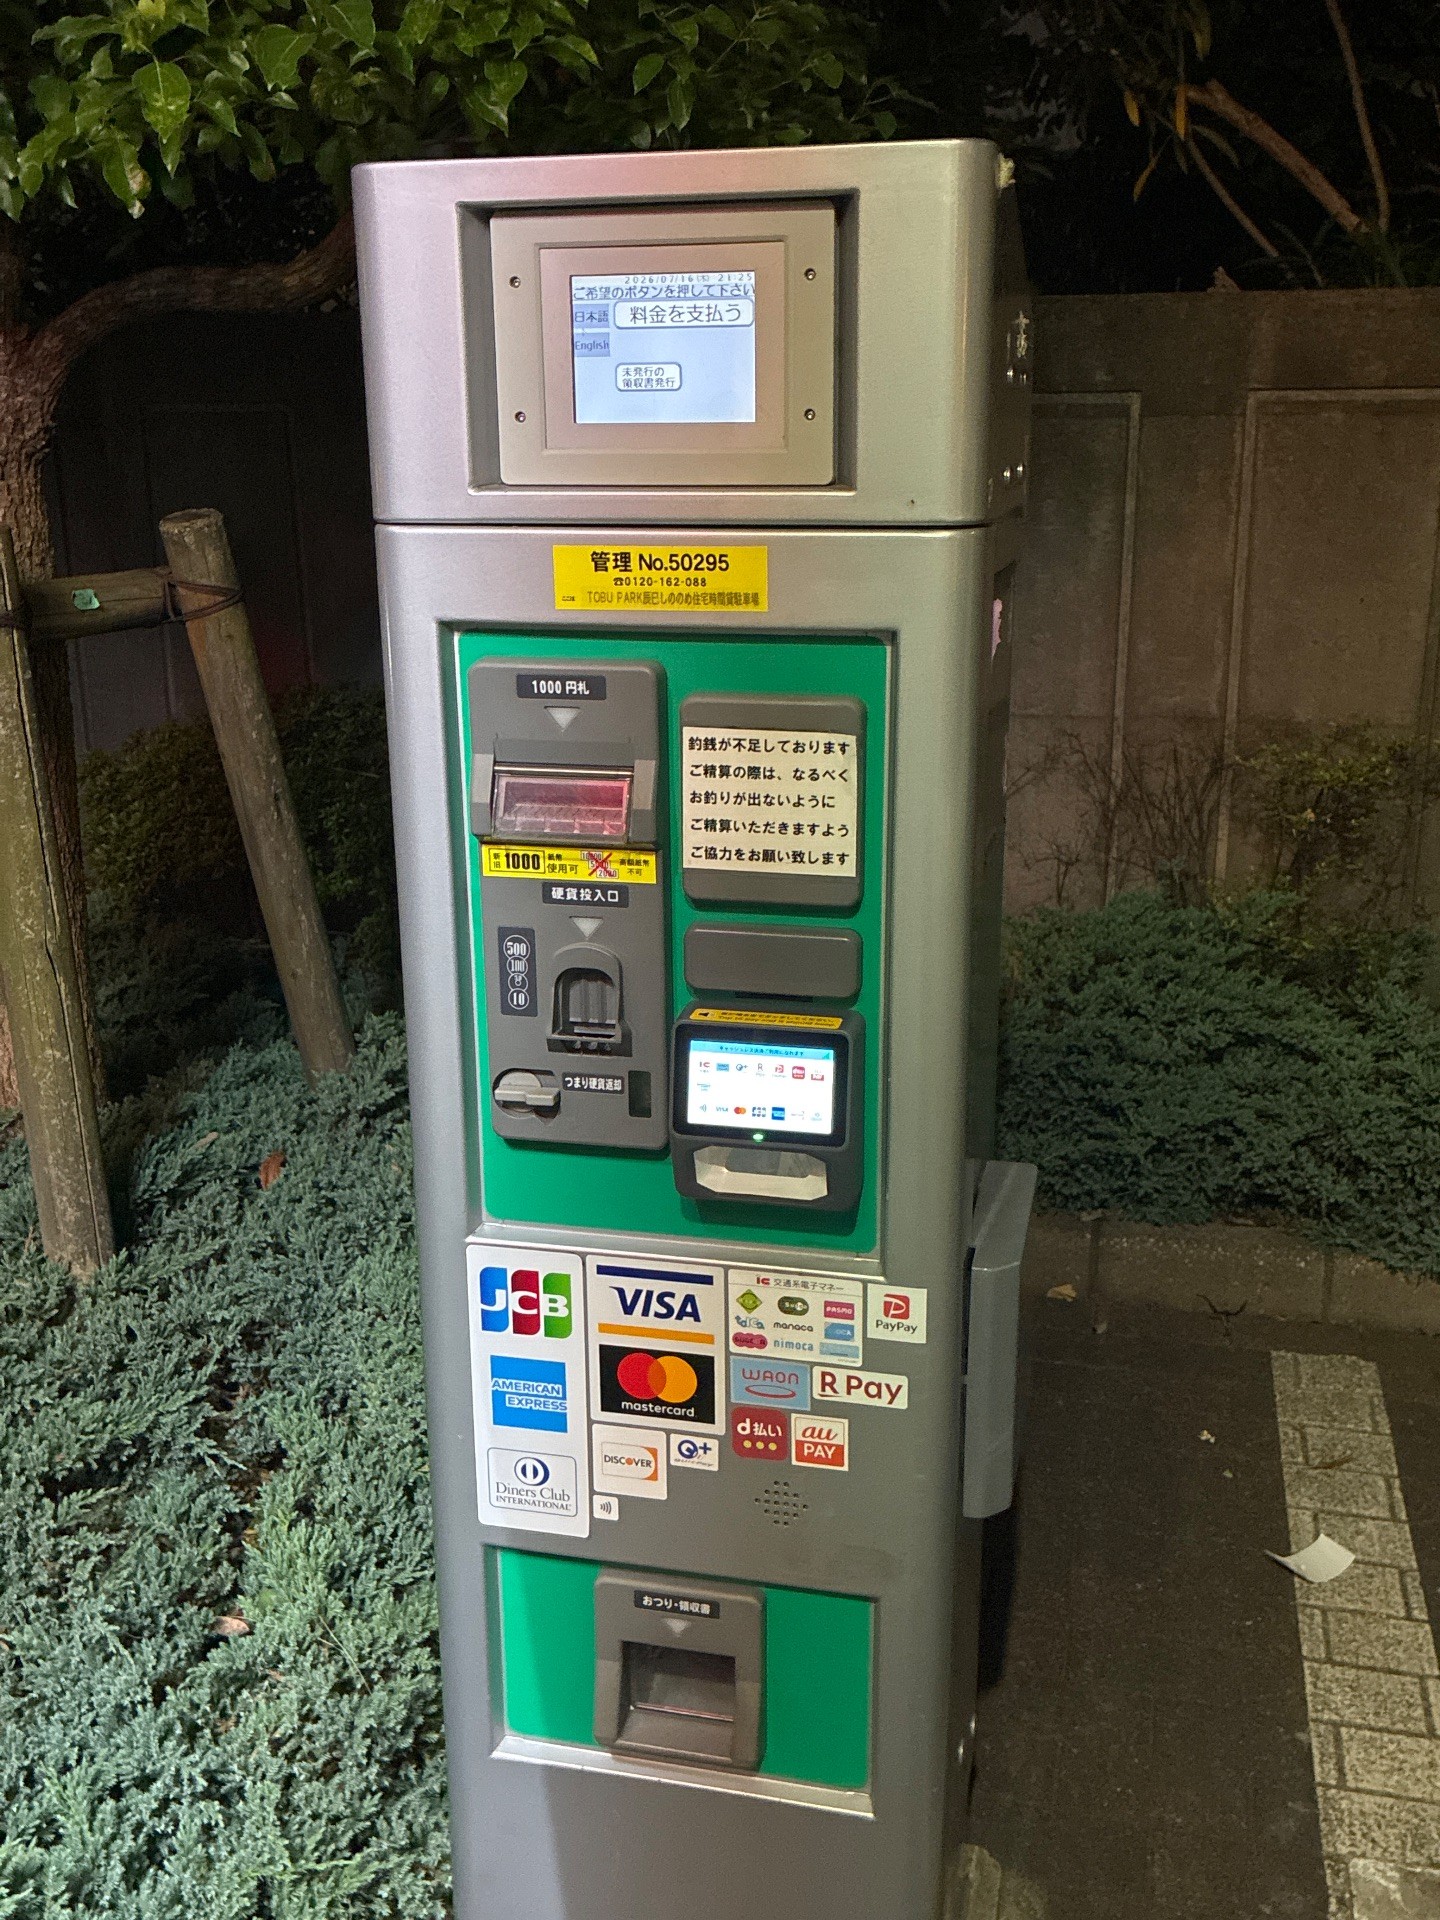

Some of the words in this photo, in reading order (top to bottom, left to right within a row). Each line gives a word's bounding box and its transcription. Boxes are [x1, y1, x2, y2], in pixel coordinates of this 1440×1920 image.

[573, 284, 755, 299] ご希望のボタンを押して下さい
[574, 310, 609, 323] 日本語
[629, 304, 741, 324] 料金を支払う
[575, 340, 609, 351] English
[622, 367, 665, 377] 未発行の
[622, 377, 675, 388] 領収書発行
[590, 551, 632, 572] 管理
[639, 553, 729, 572] No.50295
[625, 577, 707, 587] 0120-162-088
[587, 591, 613, 603] TOBU
[532, 680, 562, 694] 1000
[565, 681, 590, 695] 円札
[688, 736, 851, 755] 釣銭が不足しております
[689, 764, 849, 782] ご精算の際は、なるべく
[689, 791, 835, 808] お釣りが出ないように
[690, 818, 849, 837] ご精算いただきますよう
[505, 852, 541, 870] 1000
[691, 846, 849, 865] ご協力をお願い致します
[547, 863, 579, 875] 使用可
[627, 868, 642, 876] 不可
[552, 887, 619, 902] 硬貨投入口
[507, 942, 526, 956] 500
[510, 960, 525, 972] 100
[513, 992, 525, 1006] 10
[565, 1076, 622, 1092] つまり硬貨返却
[609, 1286, 701, 1323] VISA
[773, 1322, 814, 1332] manaca
[876, 1319, 918, 1335] PayPay
[773, 1338, 814, 1352] nimoca
[492, 1379, 561, 1396] AMERICAN
[820, 1371, 840, 1395] R
[846, 1375, 903, 1405] Pay
[507, 1396, 568, 1412] EXPRESS
[621, 1401, 695, 1417] mastercard
[737, 1418, 782, 1437] d払い
[801, 1426, 838, 1441] au
[803, 1443, 836, 1459] PAY
[604, 1454, 652, 1468] DISCOVER
[496, 1481, 537, 1498] Diners
[540, 1487, 570, 1502] Club
[496, 1495, 572, 1512] INTERNATIONAL
